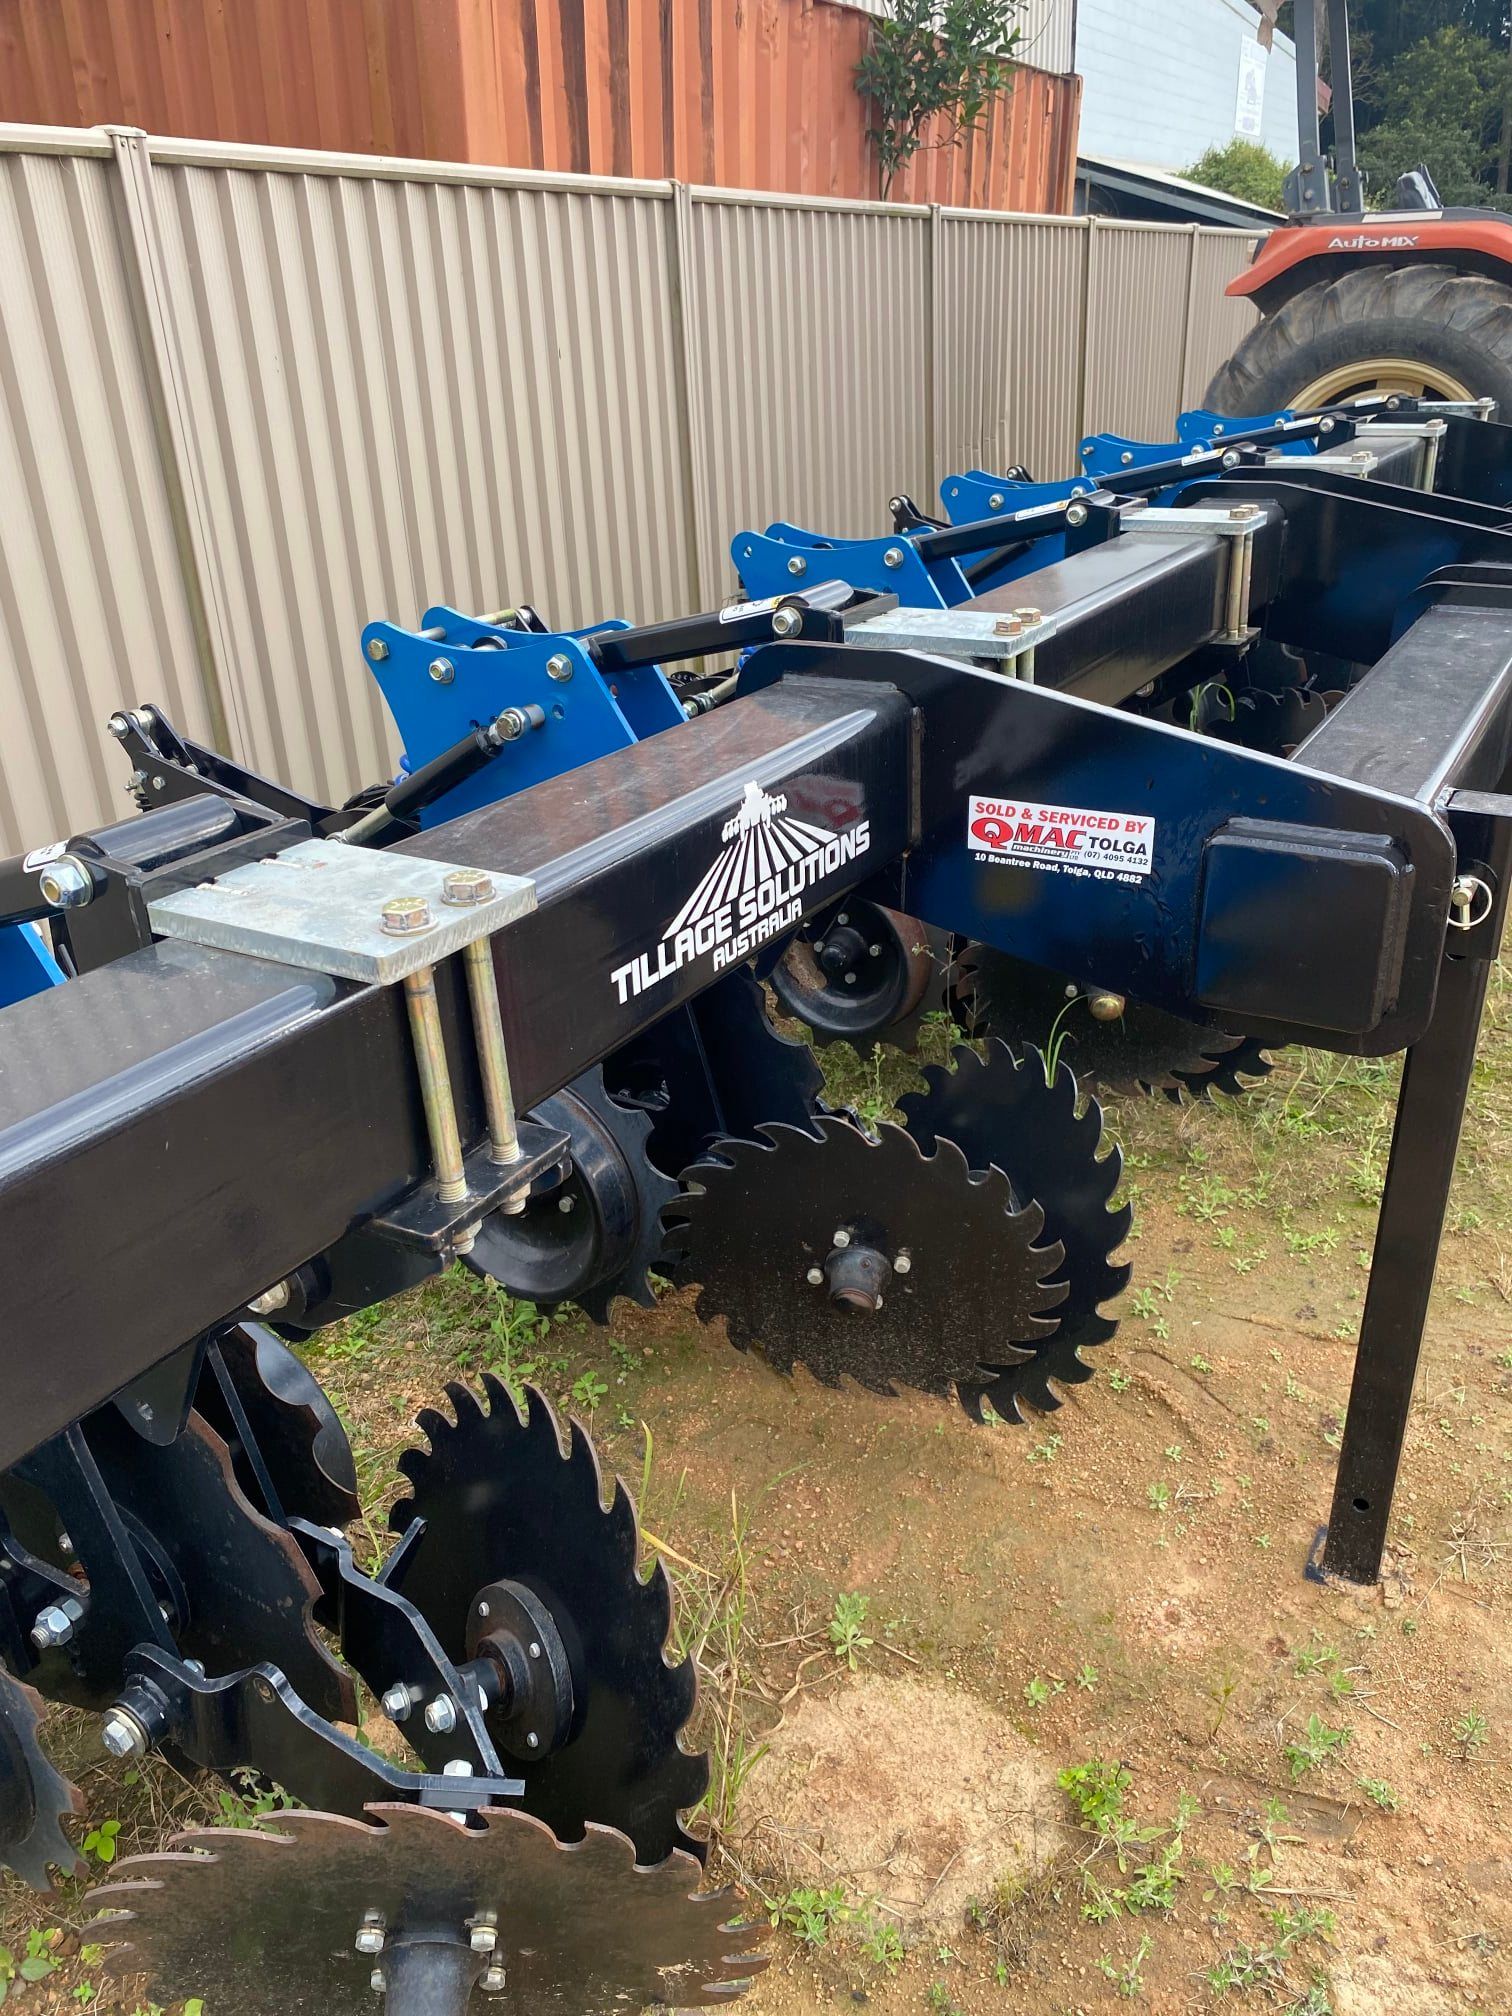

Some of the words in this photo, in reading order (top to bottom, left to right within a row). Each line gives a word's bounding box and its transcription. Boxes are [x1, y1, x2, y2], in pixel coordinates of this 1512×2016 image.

[970, 817, 1087, 850] QMAC
[975, 802, 1016, 818] SOLD
[1021, 808, 1033, 820] &
[1038, 810, 1120, 830] SERVICED
[1124, 820, 1148, 834] BY
[1012, 843, 1069, 858] machinery
[1083, 850, 1101, 860] (07)
[1103, 853, 1124, 863] 4095
[1126, 856, 1149, 866] 4132
[1089, 836, 1147, 856] TOLGA
[974, 852, 986, 862] 10
[1032, 860, 1060, 874] Road,
[1063, 864, 1092, 878] Tolga,
[1093, 869, 1115, 880] QLD
[1116, 872, 1143, 884] 4882
[610, 905, 733, 1005] TILLAGE
[738, 820, 870, 930] SOLUTIONS
[712, 898, 803, 973] AUSTRALIA
